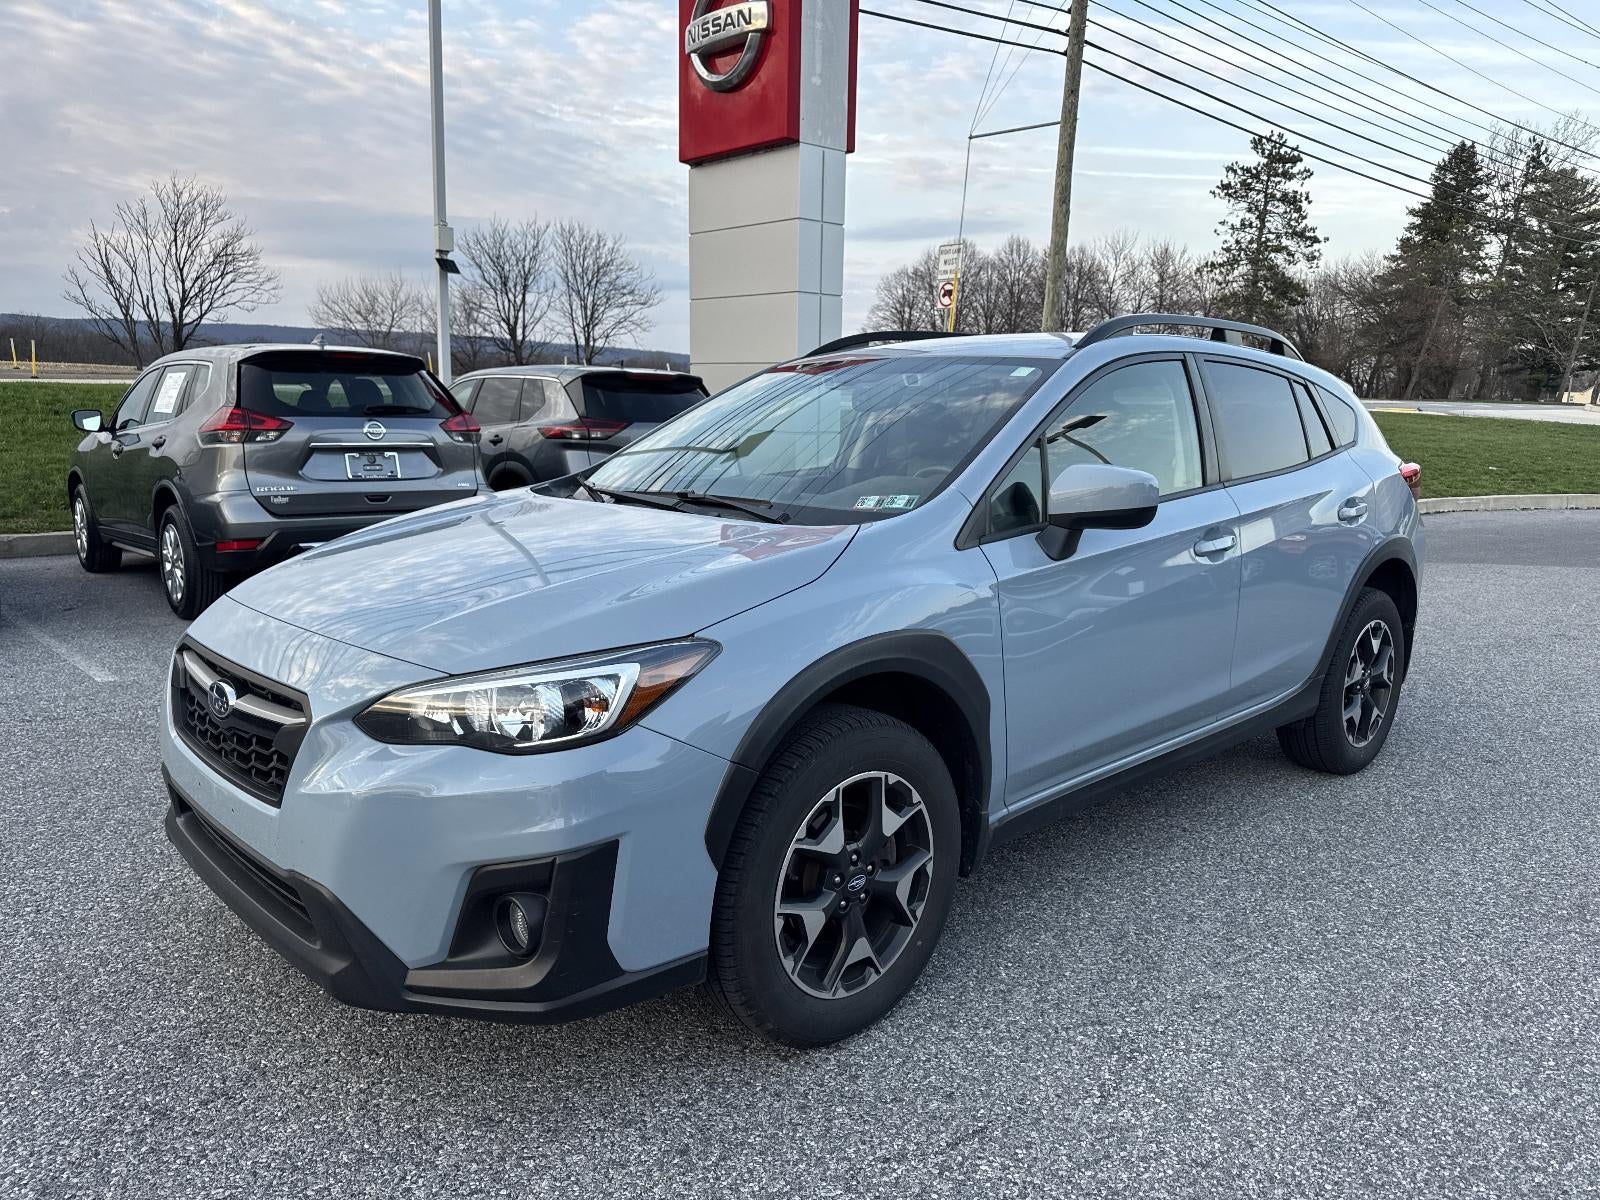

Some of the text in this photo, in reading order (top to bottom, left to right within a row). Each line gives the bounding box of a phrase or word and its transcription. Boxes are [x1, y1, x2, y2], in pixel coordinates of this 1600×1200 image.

[687, 7, 752, 47] NISSAN
[944, 258, 957, 266] MUST
[886, 497, 898, 506] 26
